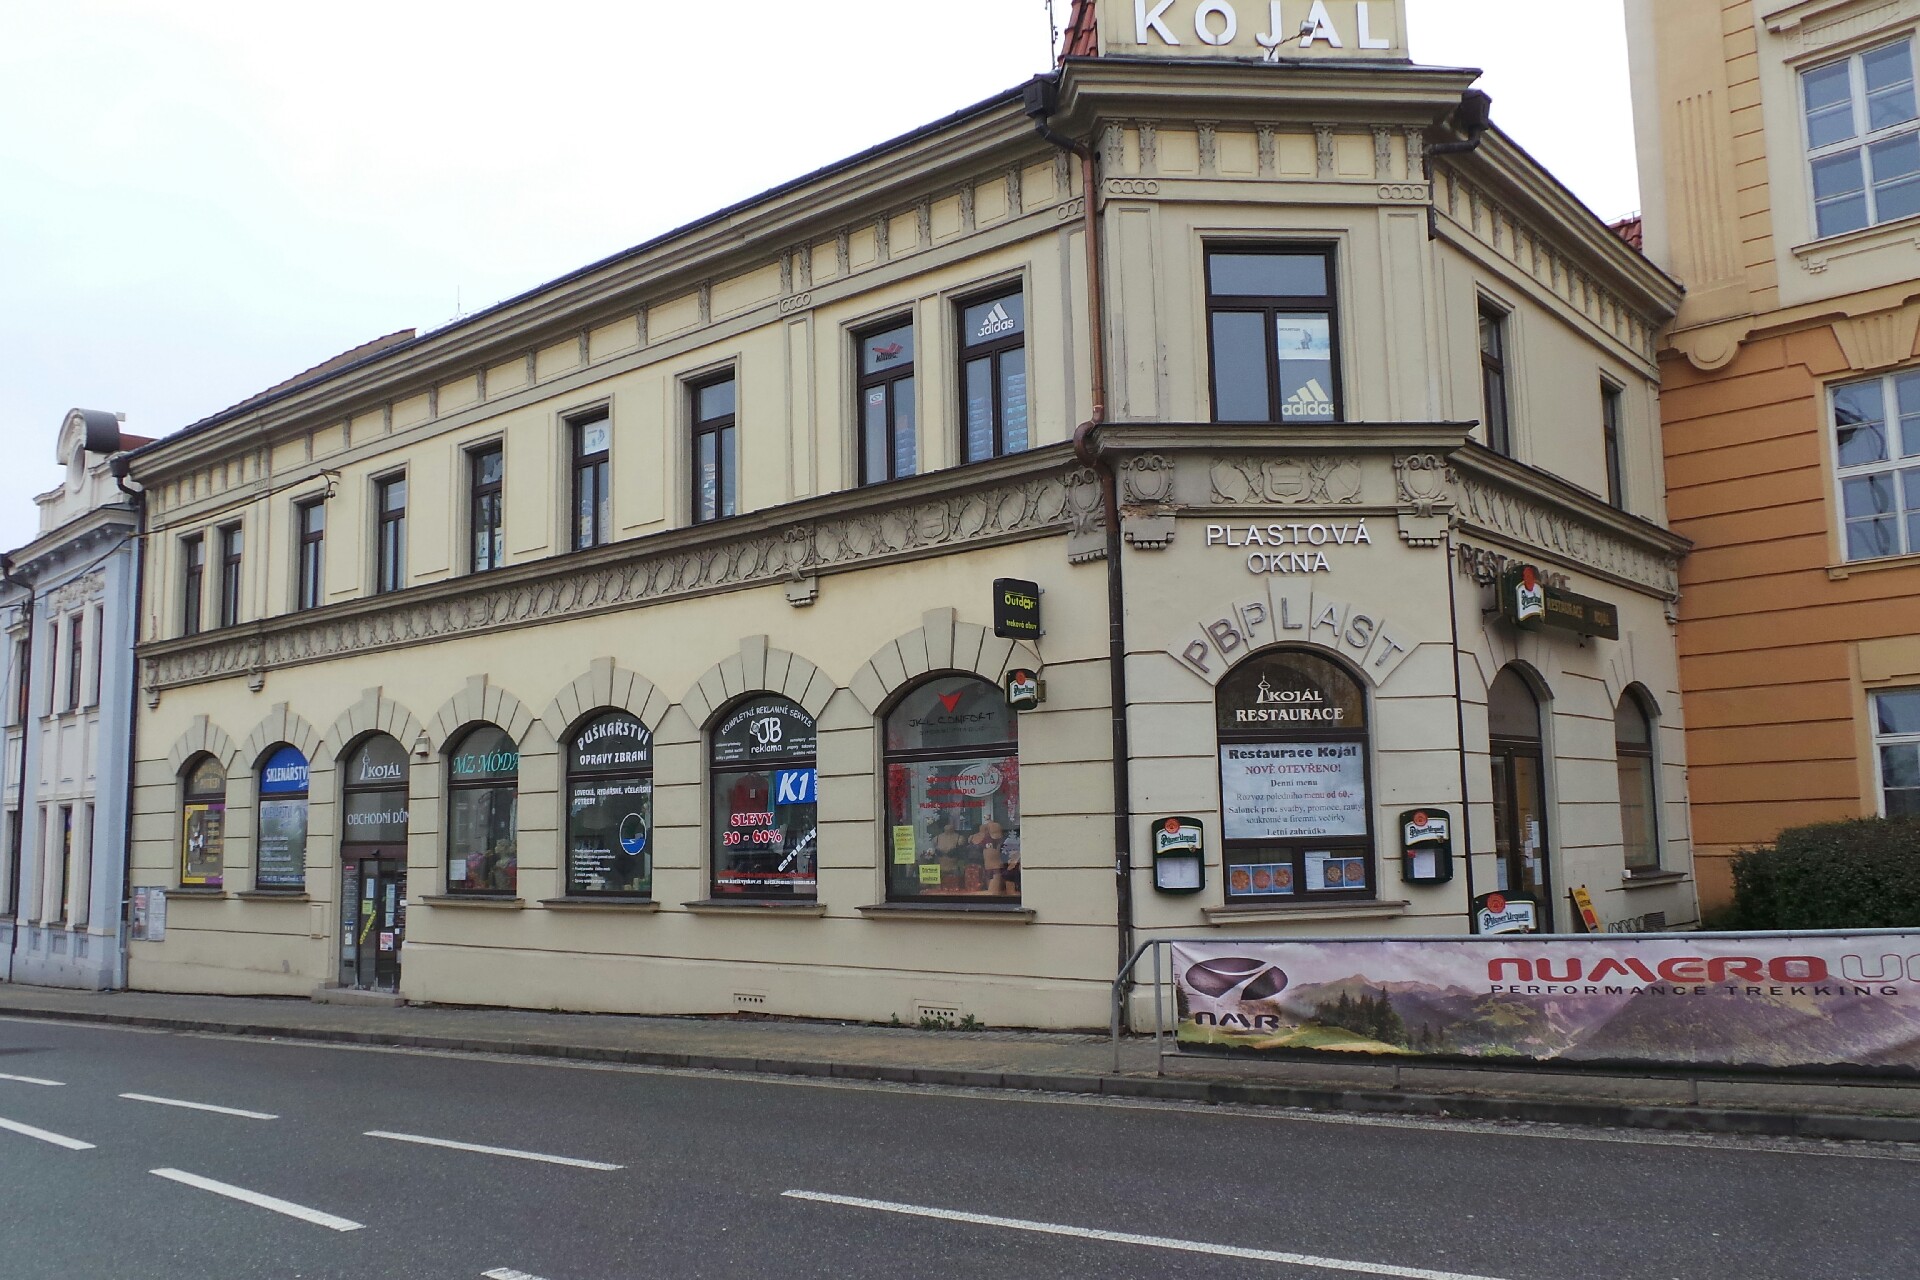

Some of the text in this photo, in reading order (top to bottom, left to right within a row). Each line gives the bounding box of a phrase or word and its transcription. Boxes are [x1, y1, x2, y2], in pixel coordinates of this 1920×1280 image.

[977, 318, 1014, 337] adidas
[1281, 400, 1335, 416] adidas
[1206, 518, 1372, 546] PLASTOVÁ
[1247, 551, 1331, 573] OKNA
[1269, 688, 1323, 703] KOJÁL
[721, 704, 813, 736] KOMPLETNÍ REKLAMNÍ SERVIS
[908, 712, 995, 728] JKL COMFORT
[1236, 707, 1344, 722] RESTAURACE
[577, 719, 651, 751] PUŠKAŘSTVÍ
[750, 743, 783, 754] reklama
[1228, 746, 1357, 760] Restaurace Kojál
[452, 748, 520, 774] MZ MÓDA
[579, 748, 647, 766] OPRAVY ZBRANÍ
[265, 762, 310, 783] SKLENÁŘSTV
[367, 762, 402, 779] KOJÁL
[1245, 763, 1342, 775] NOVĚ OTEVŘENO!
[777, 771, 810, 803] K1
[1270, 779, 1294, 788] Denní
[1236, 793, 1265, 801] Rozvoz
[1266, 792, 1303, 802] poledního
[1326, 791, 1336, 799] od
[347, 809, 391, 825] OBCHODNÍ
[1228, 806, 1260, 814] Salonek
[1261, 806, 1278, 815] pro:
[1279, 805, 1306, 814] svatby,
[730, 811, 774, 827] SLEVY
[1246, 816, 1281, 824] soukromé
[1289, 815, 1317, 823] firemní
[1318, 814, 1346, 823] večírky
[722, 831, 741, 846] 30
[752, 828, 783, 844] 60%
[1267, 828, 1327, 836] Letní zahrádka
[1483, 910, 1530, 931] Pilsner Urquell
[1487, 955, 1829, 983] NUMERO
[1490, 984, 1899, 997] PERFORMANCE TREKKING
